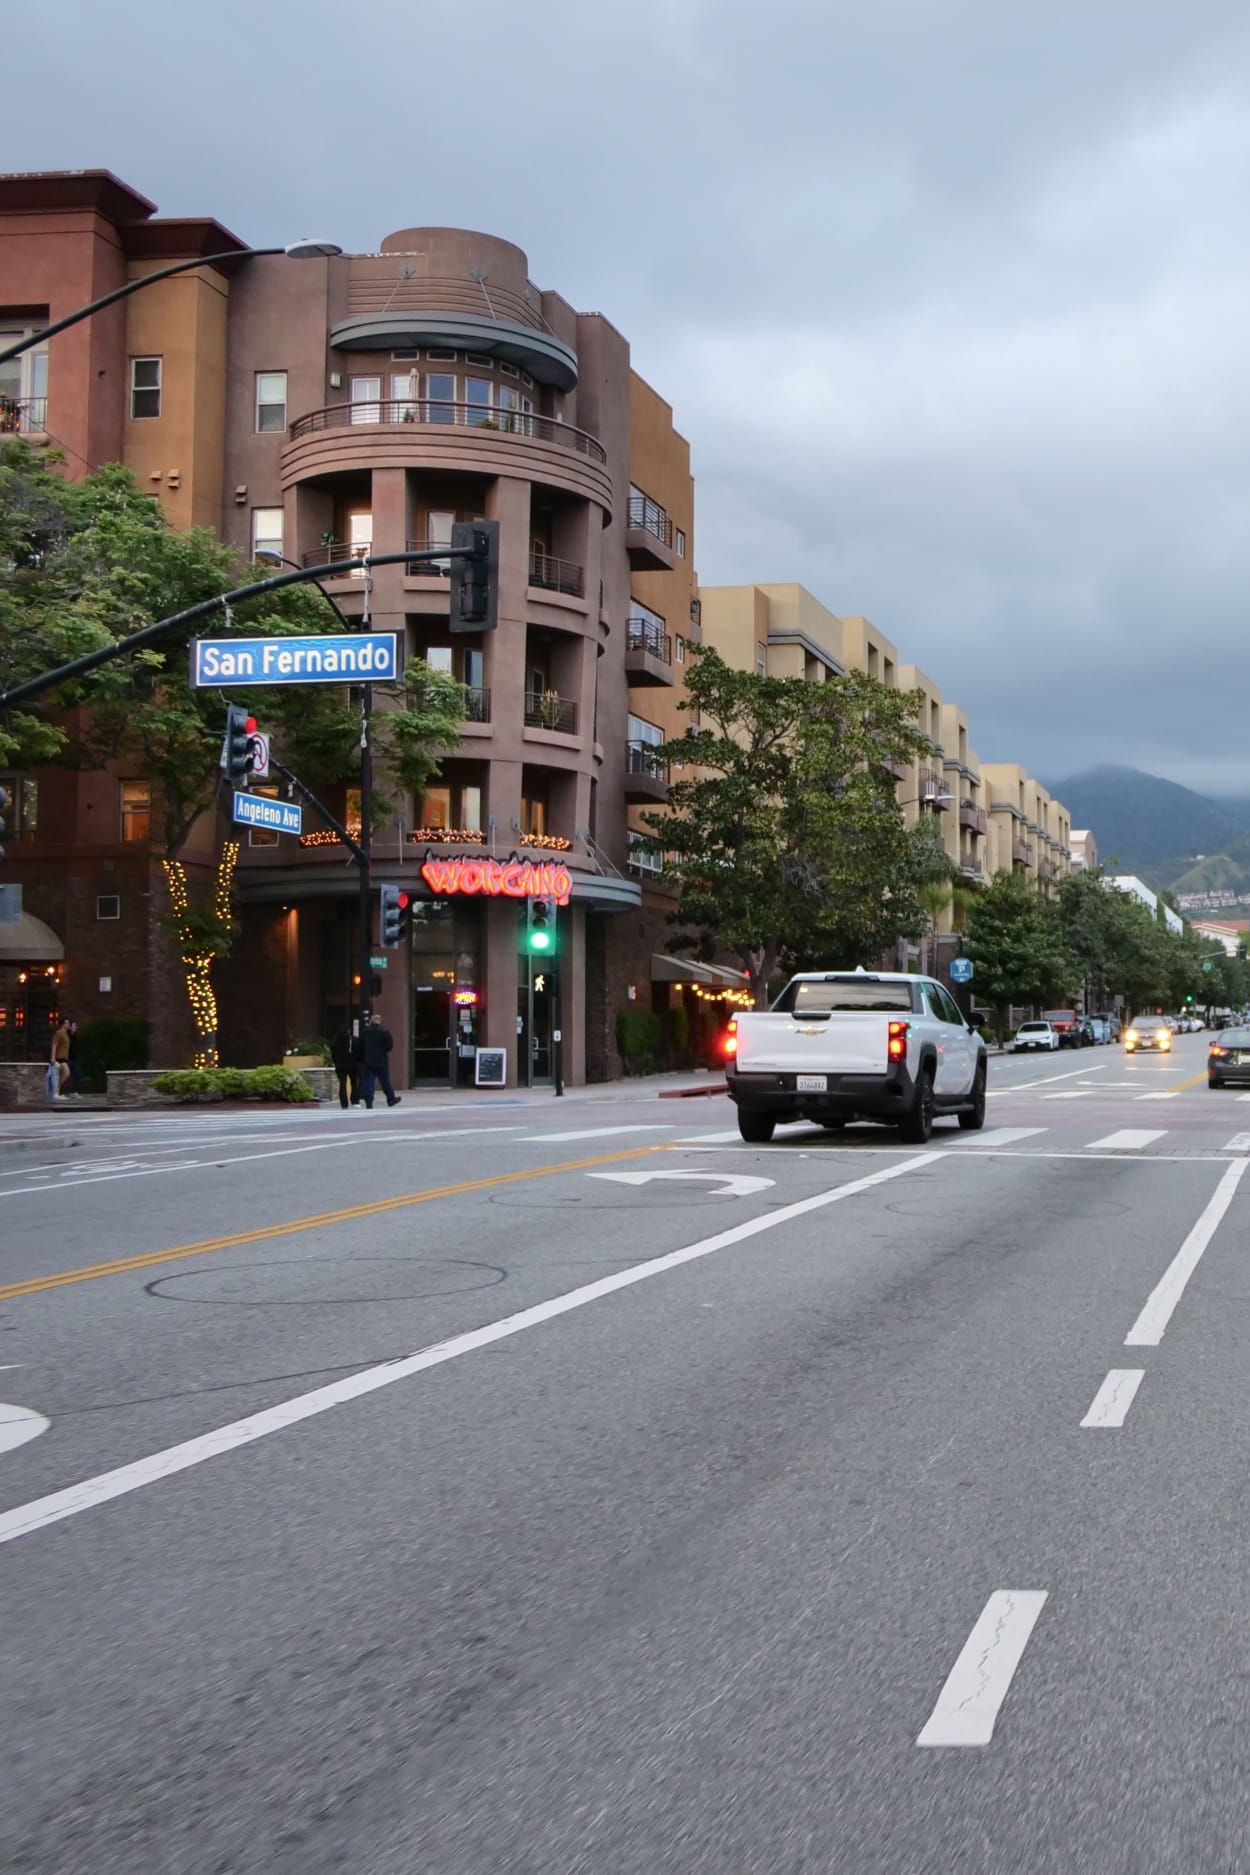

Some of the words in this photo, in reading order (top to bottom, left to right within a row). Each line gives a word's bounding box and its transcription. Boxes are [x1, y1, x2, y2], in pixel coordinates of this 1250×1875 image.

[203, 647, 253, 676] San
[262, 643, 390, 673] Fernando
[238, 798, 281, 824] Angeleno
[283, 810, 299, 828] Ave
